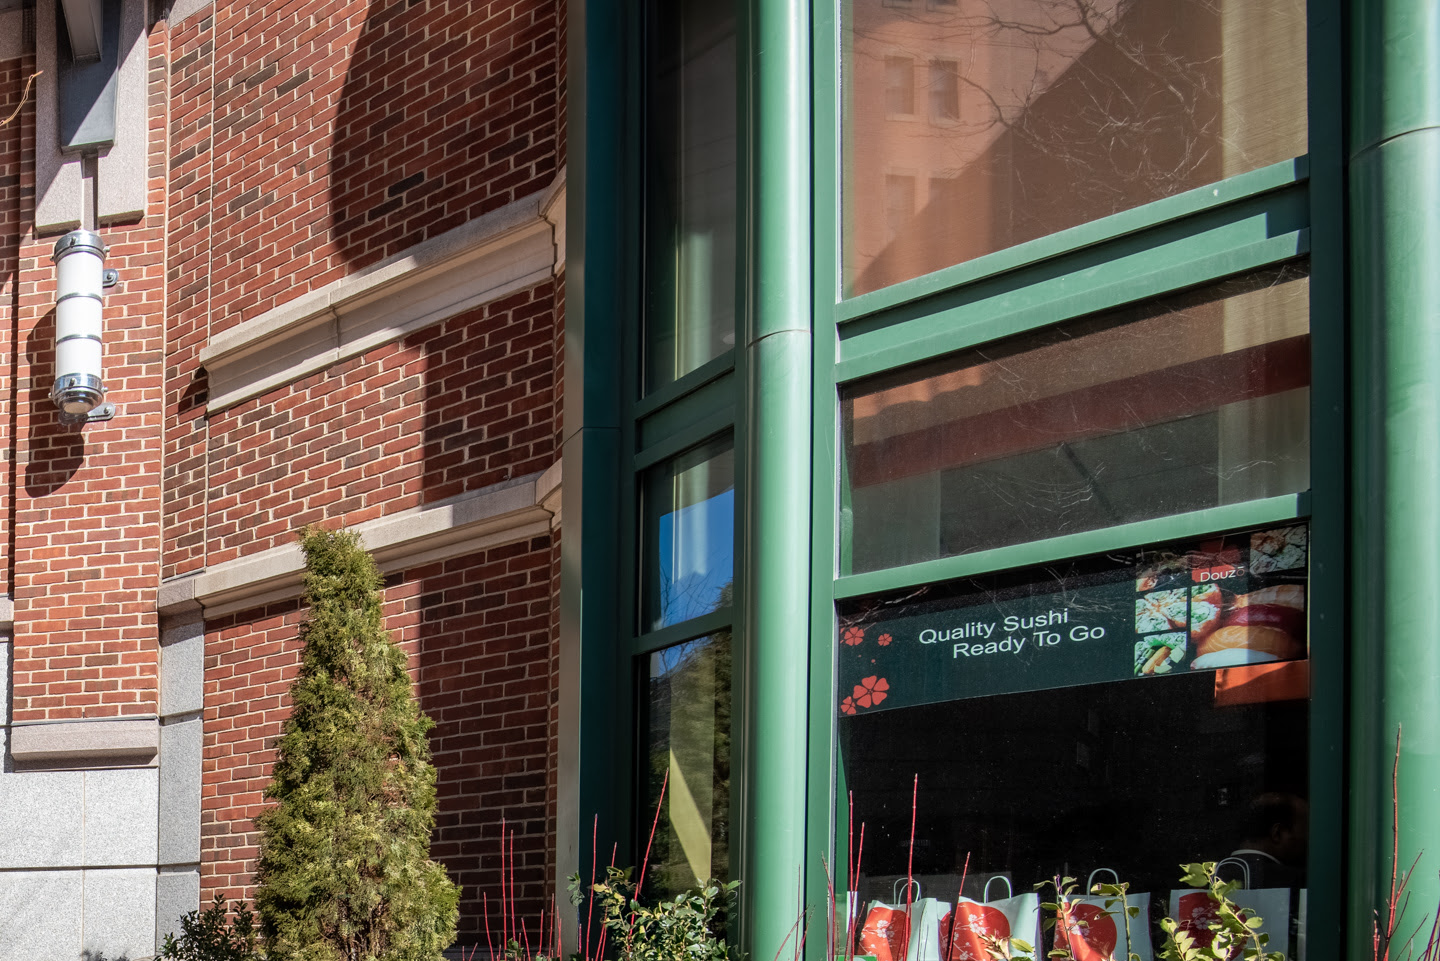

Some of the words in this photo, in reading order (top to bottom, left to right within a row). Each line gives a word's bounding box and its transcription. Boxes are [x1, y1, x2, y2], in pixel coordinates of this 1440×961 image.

[918, 622, 996, 644] Quality
[1003, 608, 1069, 632] Sushi
[953, 636, 1026, 659] Ready
[1033, 630, 1061, 647] To
[1069, 625, 1106, 642] Go
